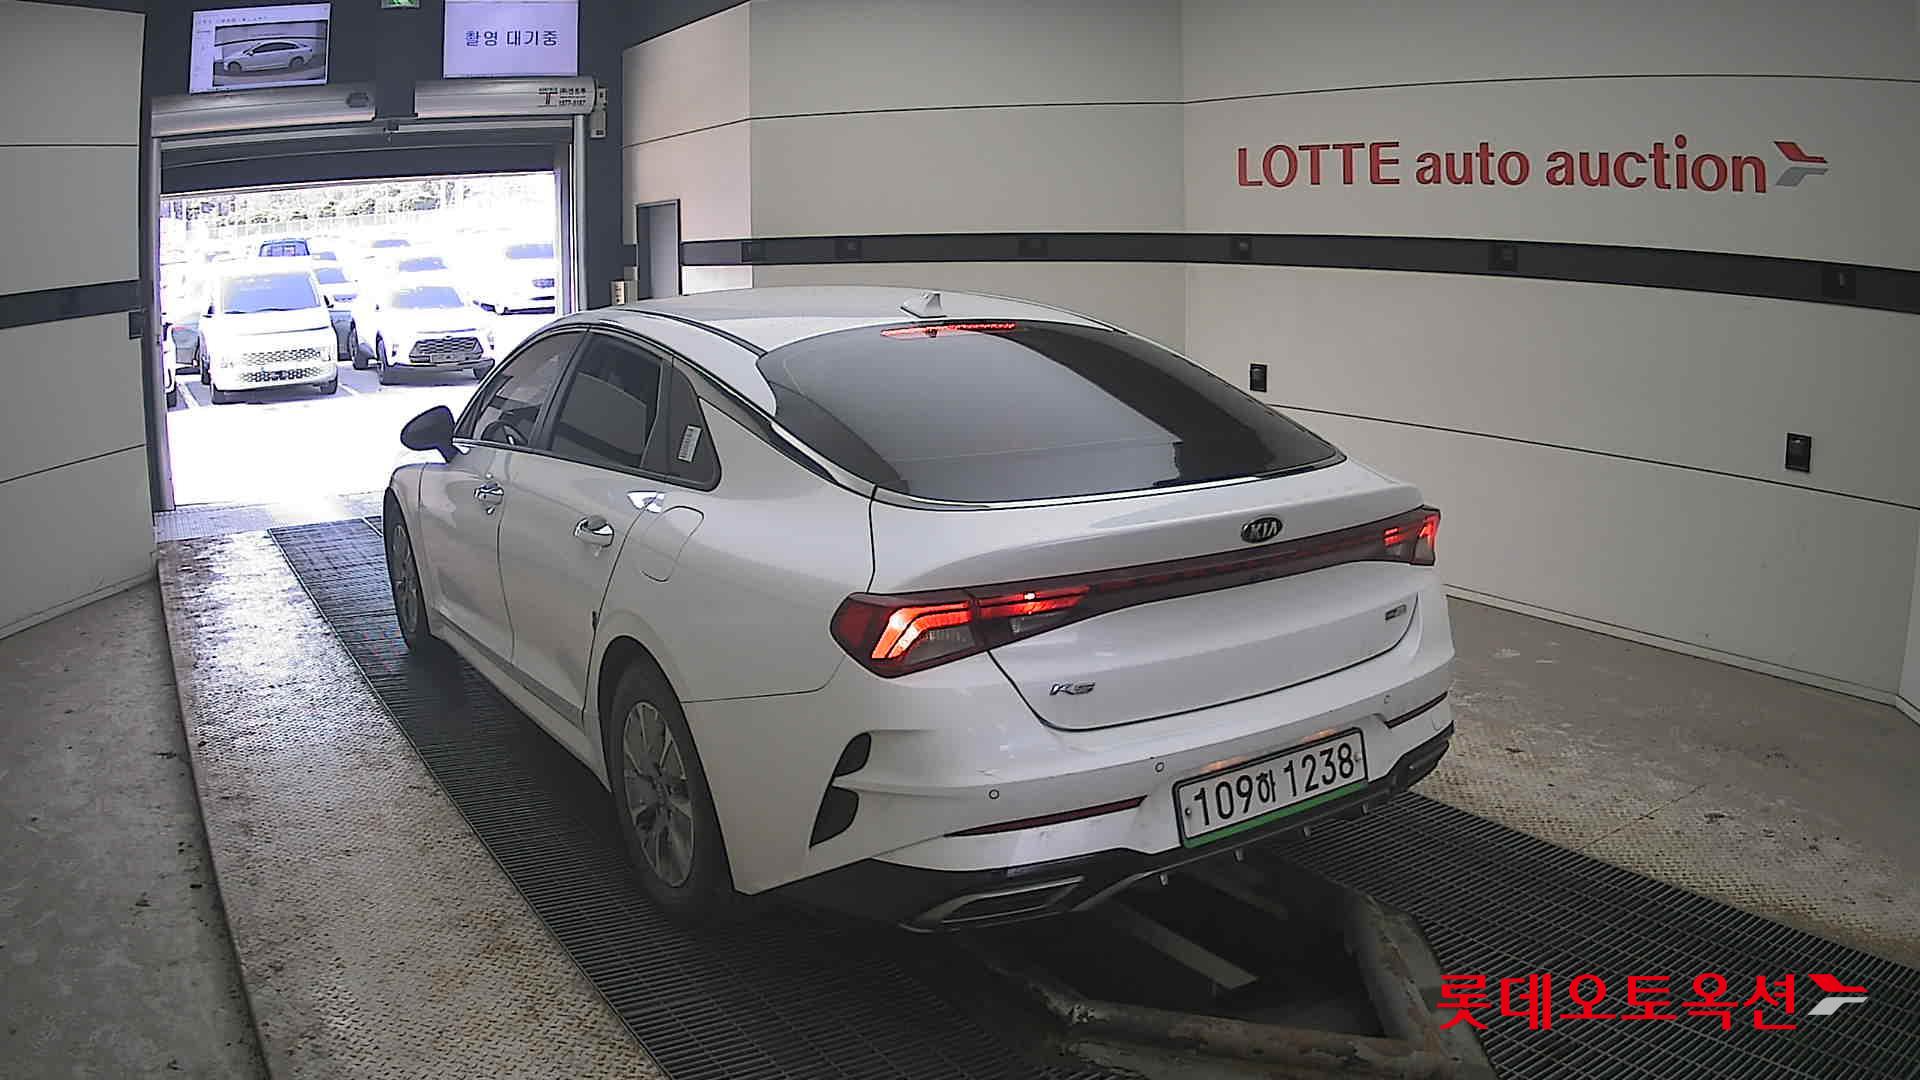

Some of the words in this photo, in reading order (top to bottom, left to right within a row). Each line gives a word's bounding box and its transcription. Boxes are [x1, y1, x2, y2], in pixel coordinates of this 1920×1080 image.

[465, 30, 498, 47] 촬영
[506, 30, 557, 47] 대기중
[1237, 141, 1400, 187] LOTTE
[1415, 143, 1530, 186] auto
[1545, 135, 1767, 194] auction
[1245, 519, 1280, 540] KIA
[1194, 769, 1276, 826] 109하
[1283, 742, 1355, 798] 1238
